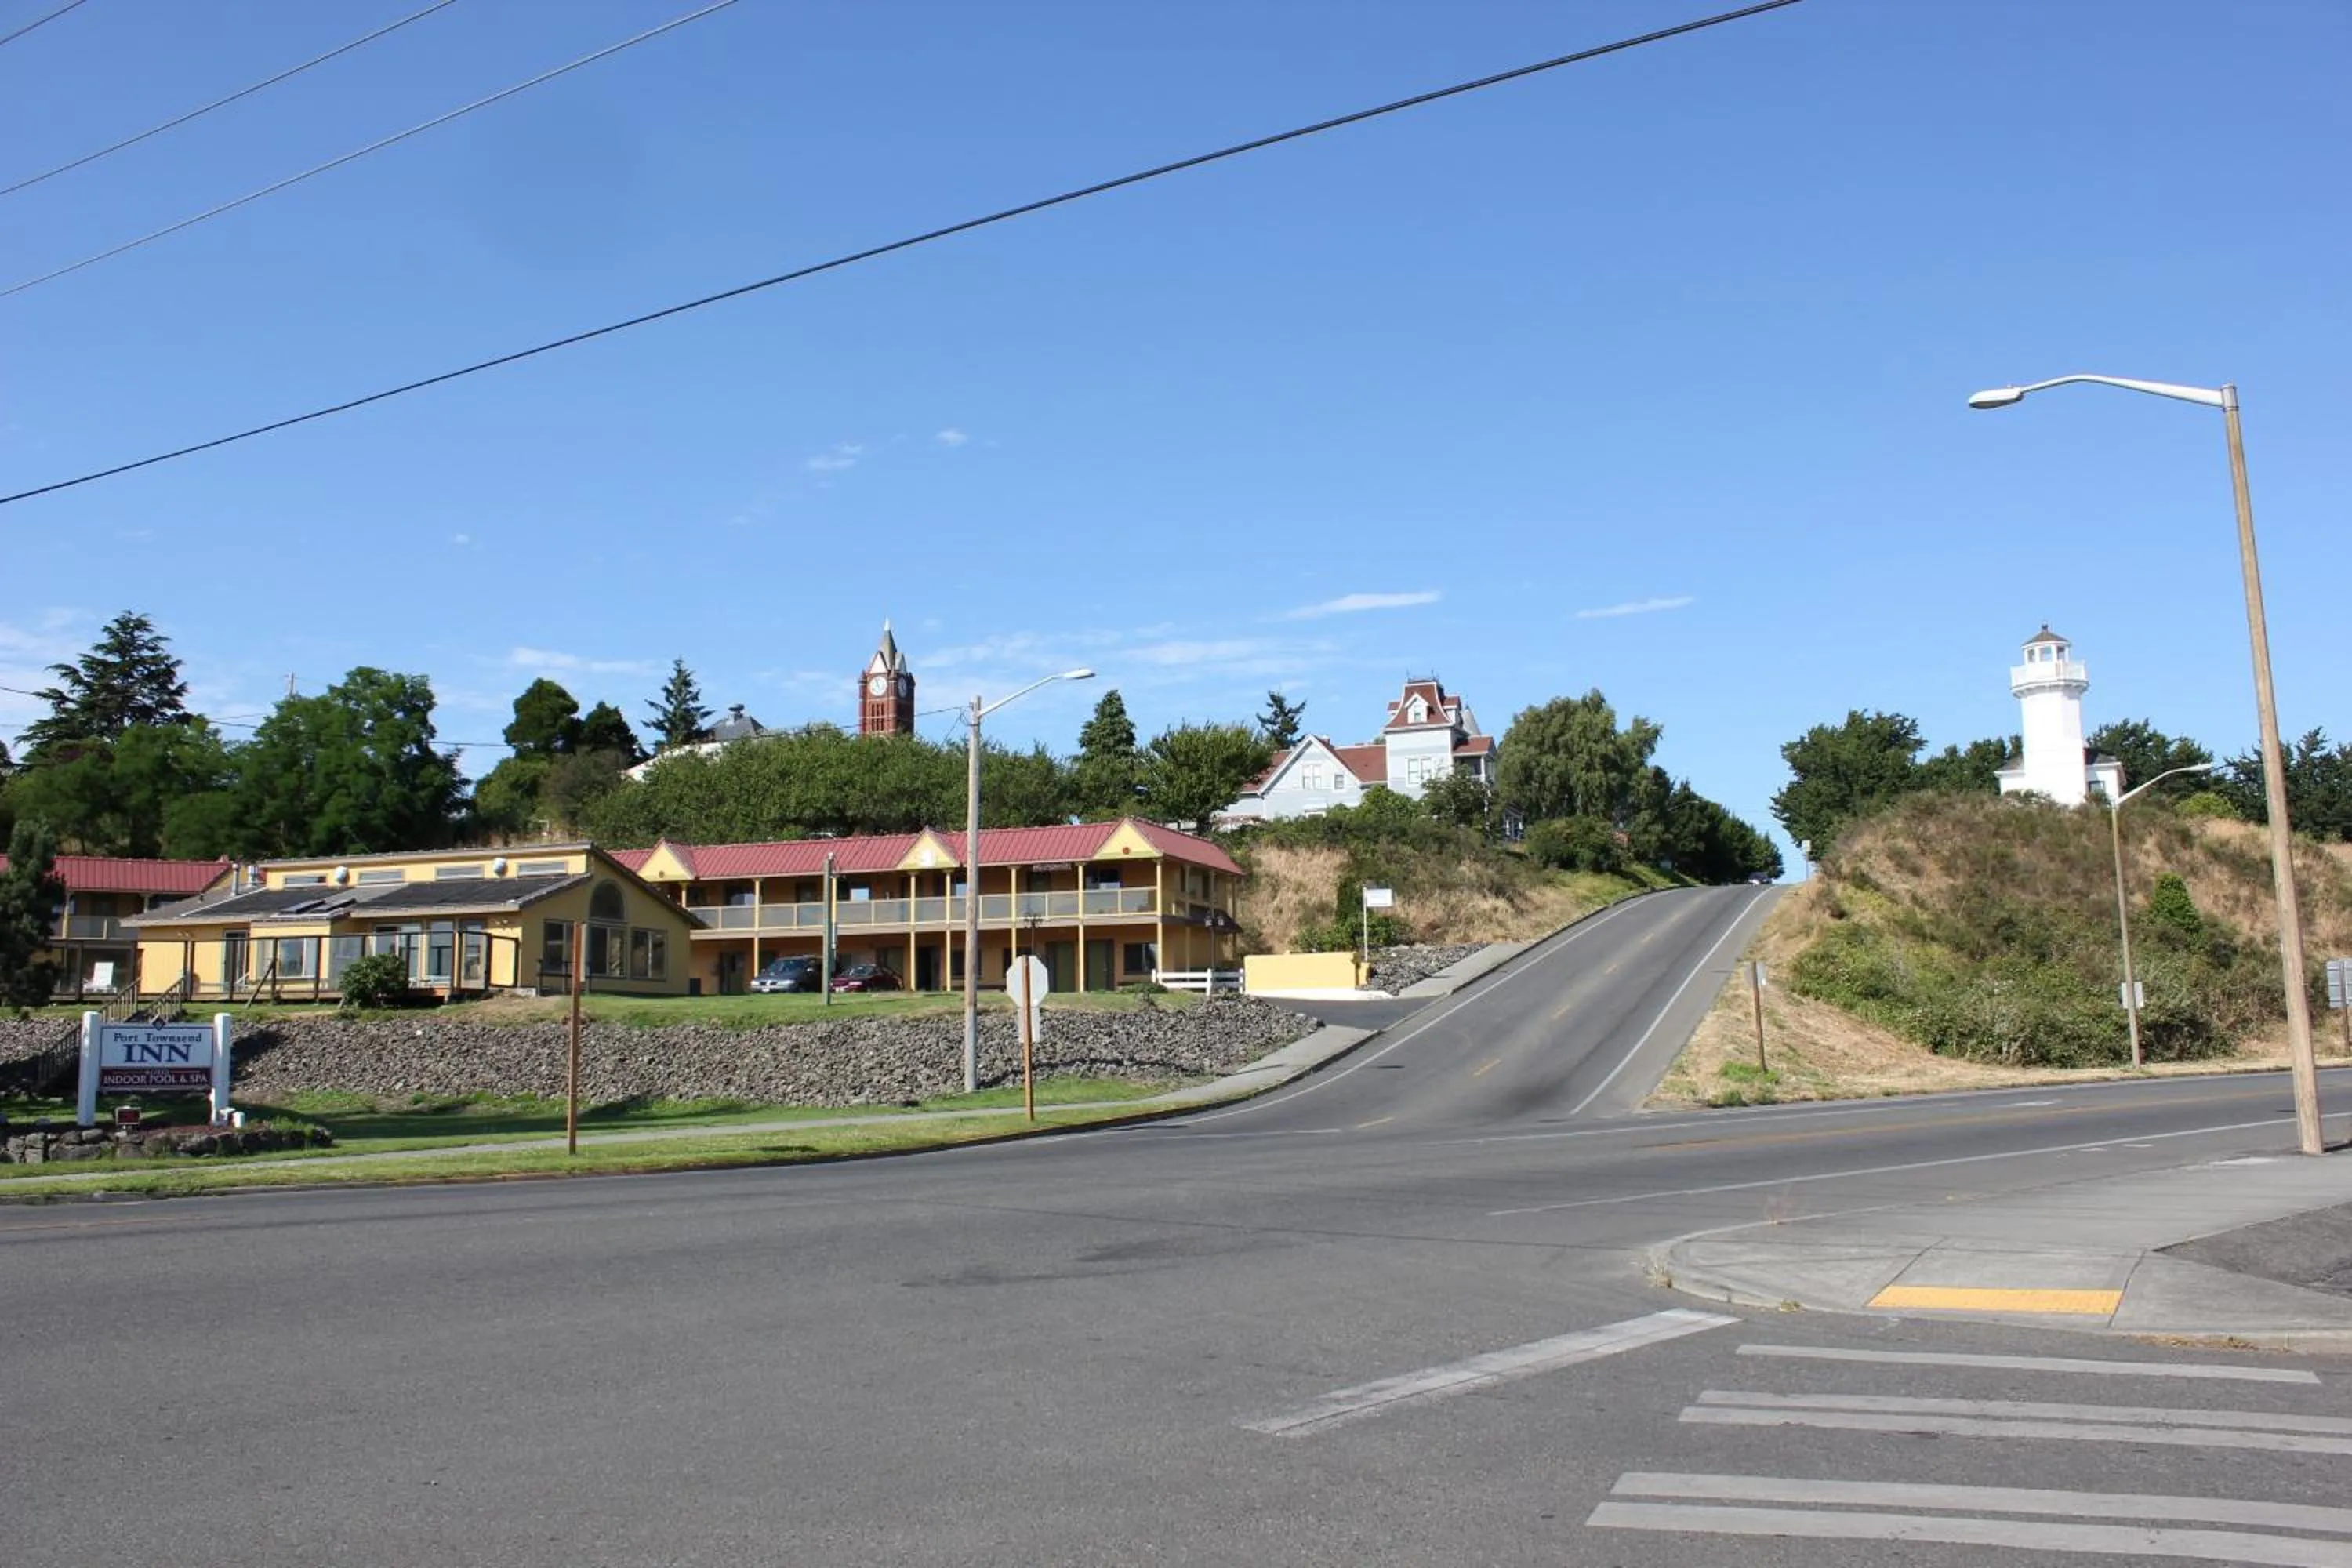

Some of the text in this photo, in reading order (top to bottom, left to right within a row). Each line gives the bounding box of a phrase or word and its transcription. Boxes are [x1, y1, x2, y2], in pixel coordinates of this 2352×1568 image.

[114, 1033, 201, 1043] Port Townsend
[124, 1044, 192, 1062] INN
[103, 1073, 208, 1084] INDOOR POOL & SPA
